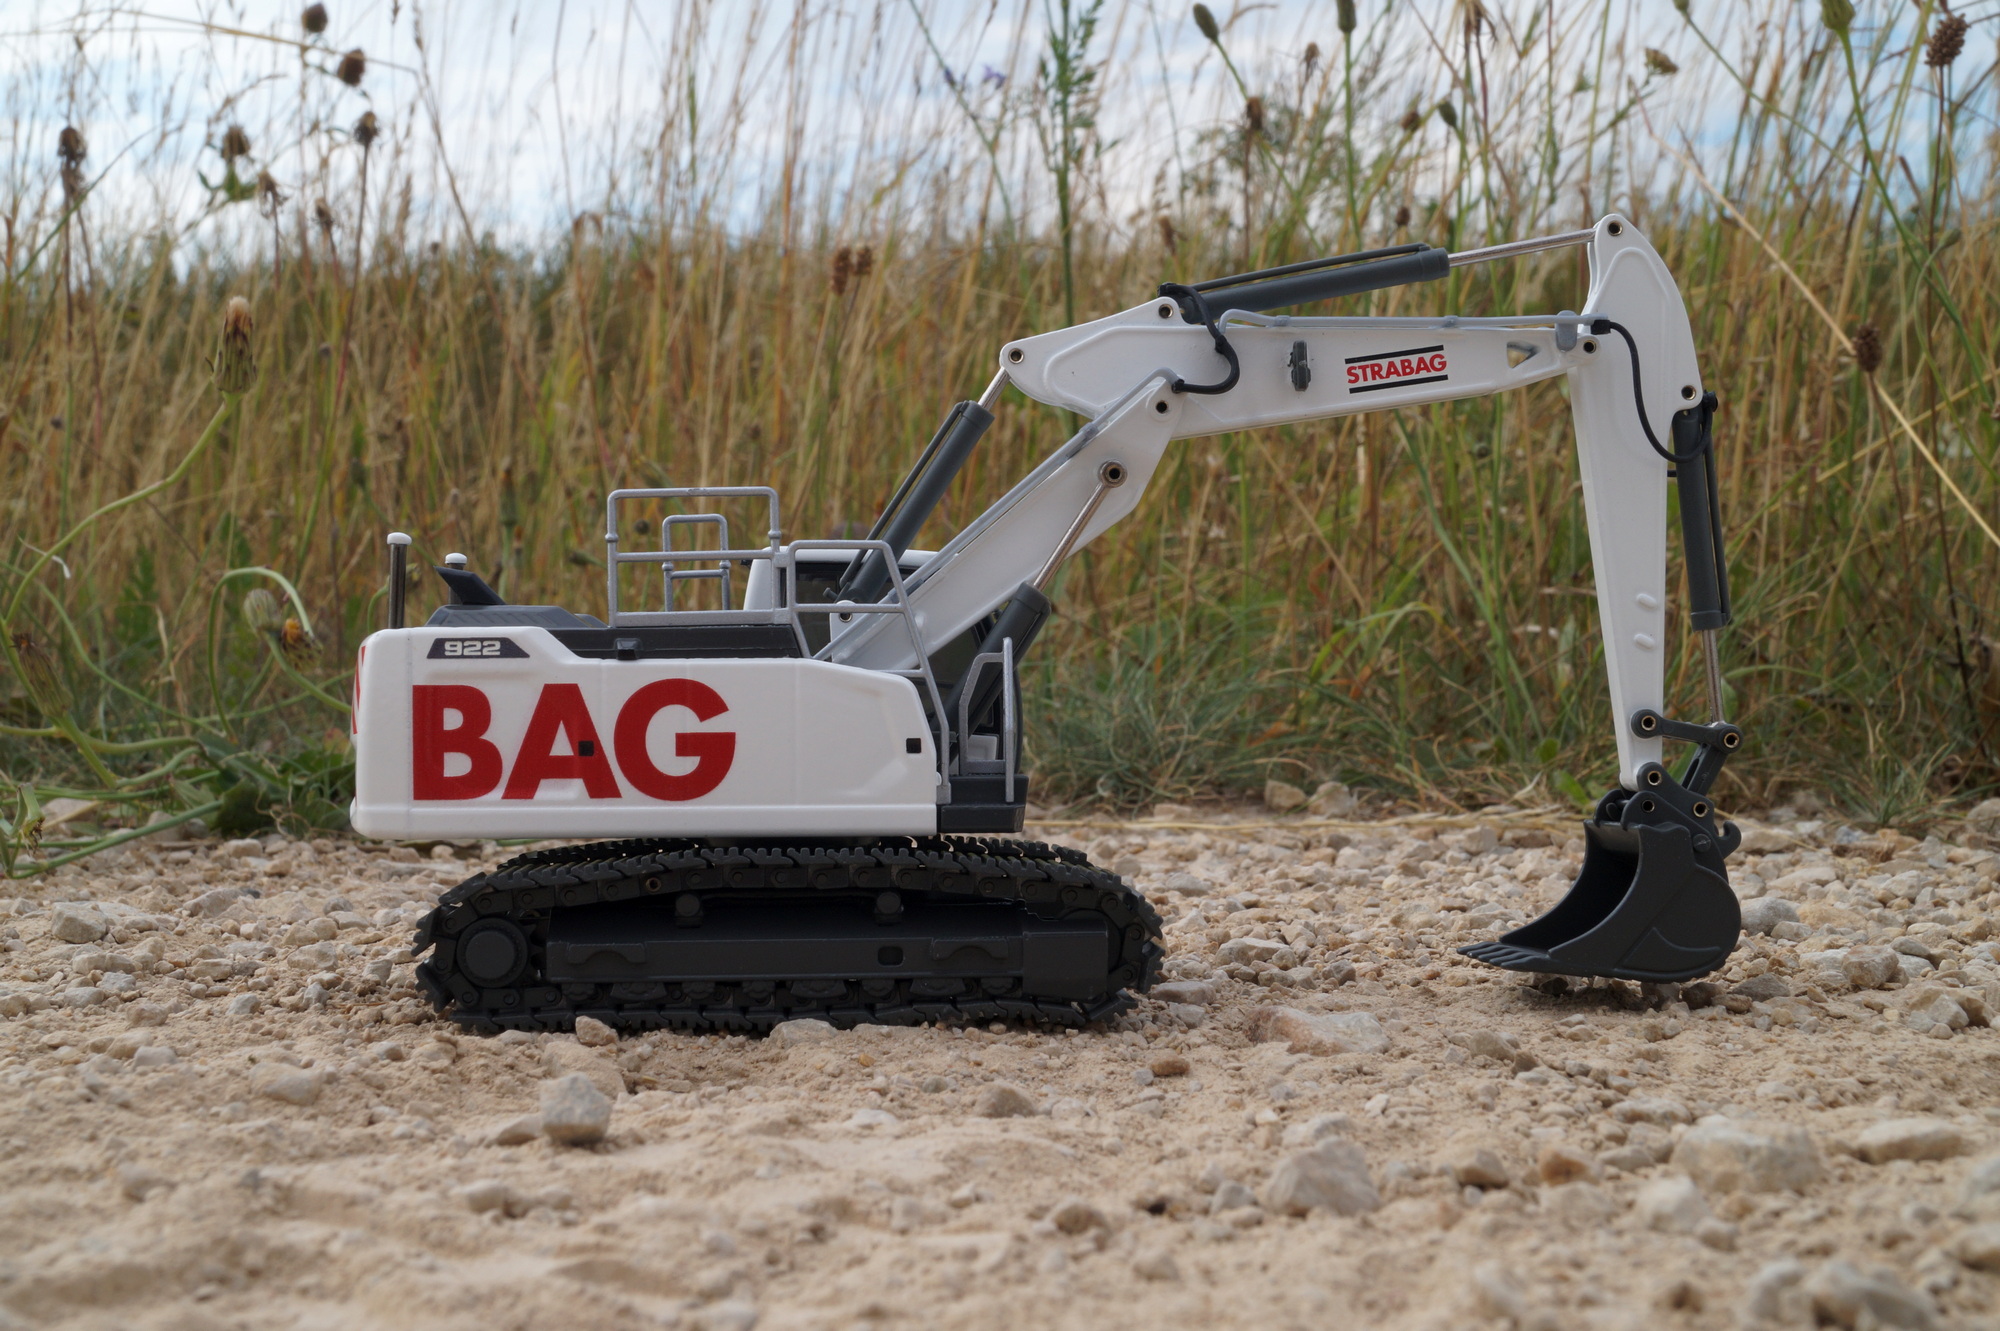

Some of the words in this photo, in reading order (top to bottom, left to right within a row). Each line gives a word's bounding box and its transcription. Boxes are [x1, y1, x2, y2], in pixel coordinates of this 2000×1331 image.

[1346, 353, 1447, 384] STRABAG
[444, 640, 501, 656] 922
[412, 678, 736, 802] BAG
